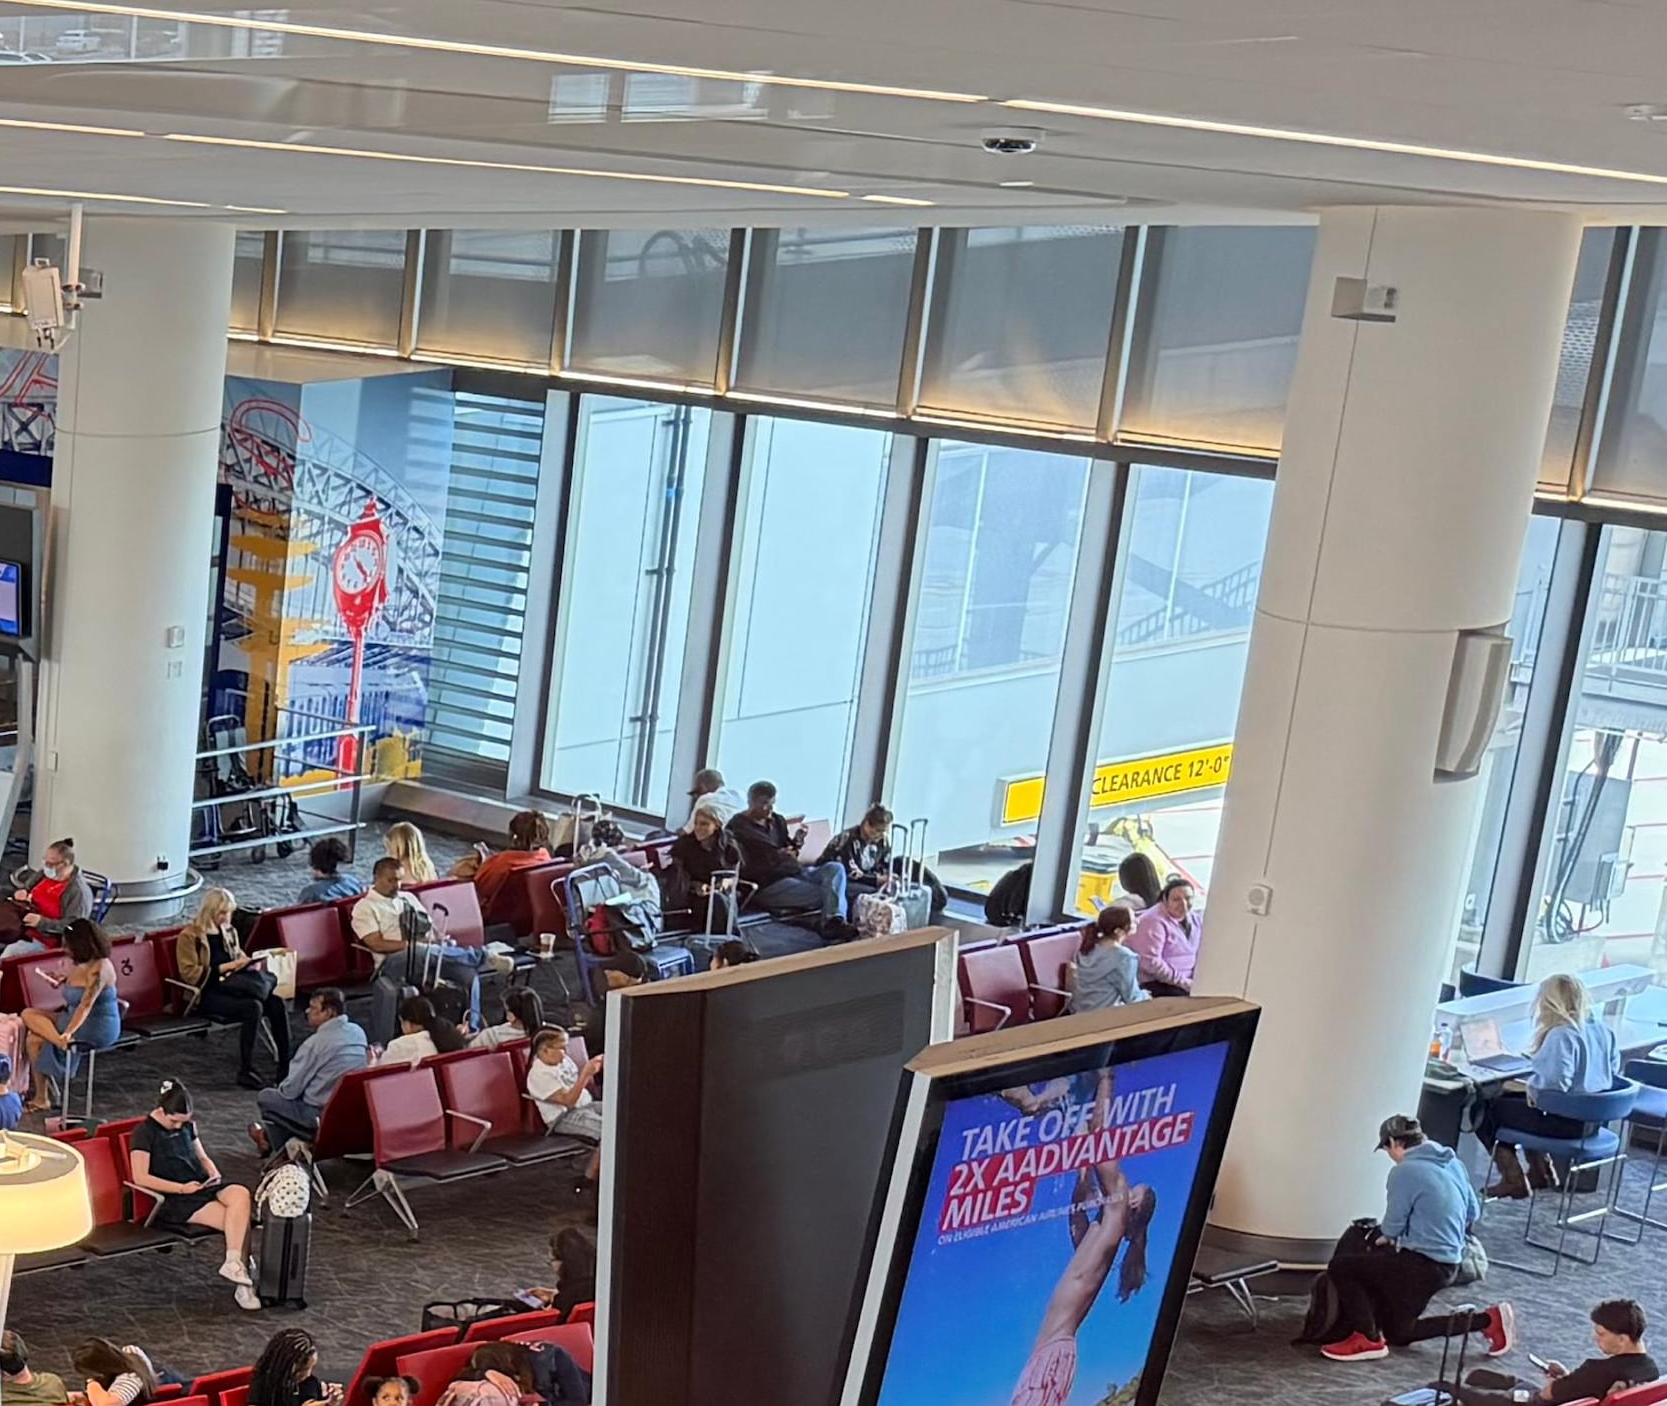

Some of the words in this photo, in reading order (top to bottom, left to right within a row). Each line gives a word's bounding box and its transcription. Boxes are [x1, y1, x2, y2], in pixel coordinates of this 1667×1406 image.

[1092, 763, 1182, 795] CLEARANCE
[961, 1115, 1034, 1161] TAKE
[1038, 1101, 1097, 1142] OFF
[1103, 1083, 1177, 1129] WITH
[950, 1160, 992, 1197] 2X
[992, 1111, 1193, 1187] AADVANTAGE
[937, 1232, 953, 1246] ON
[991, 1213, 1037, 1233] AMERICAN
[941, 1180, 1031, 1232] MILES
